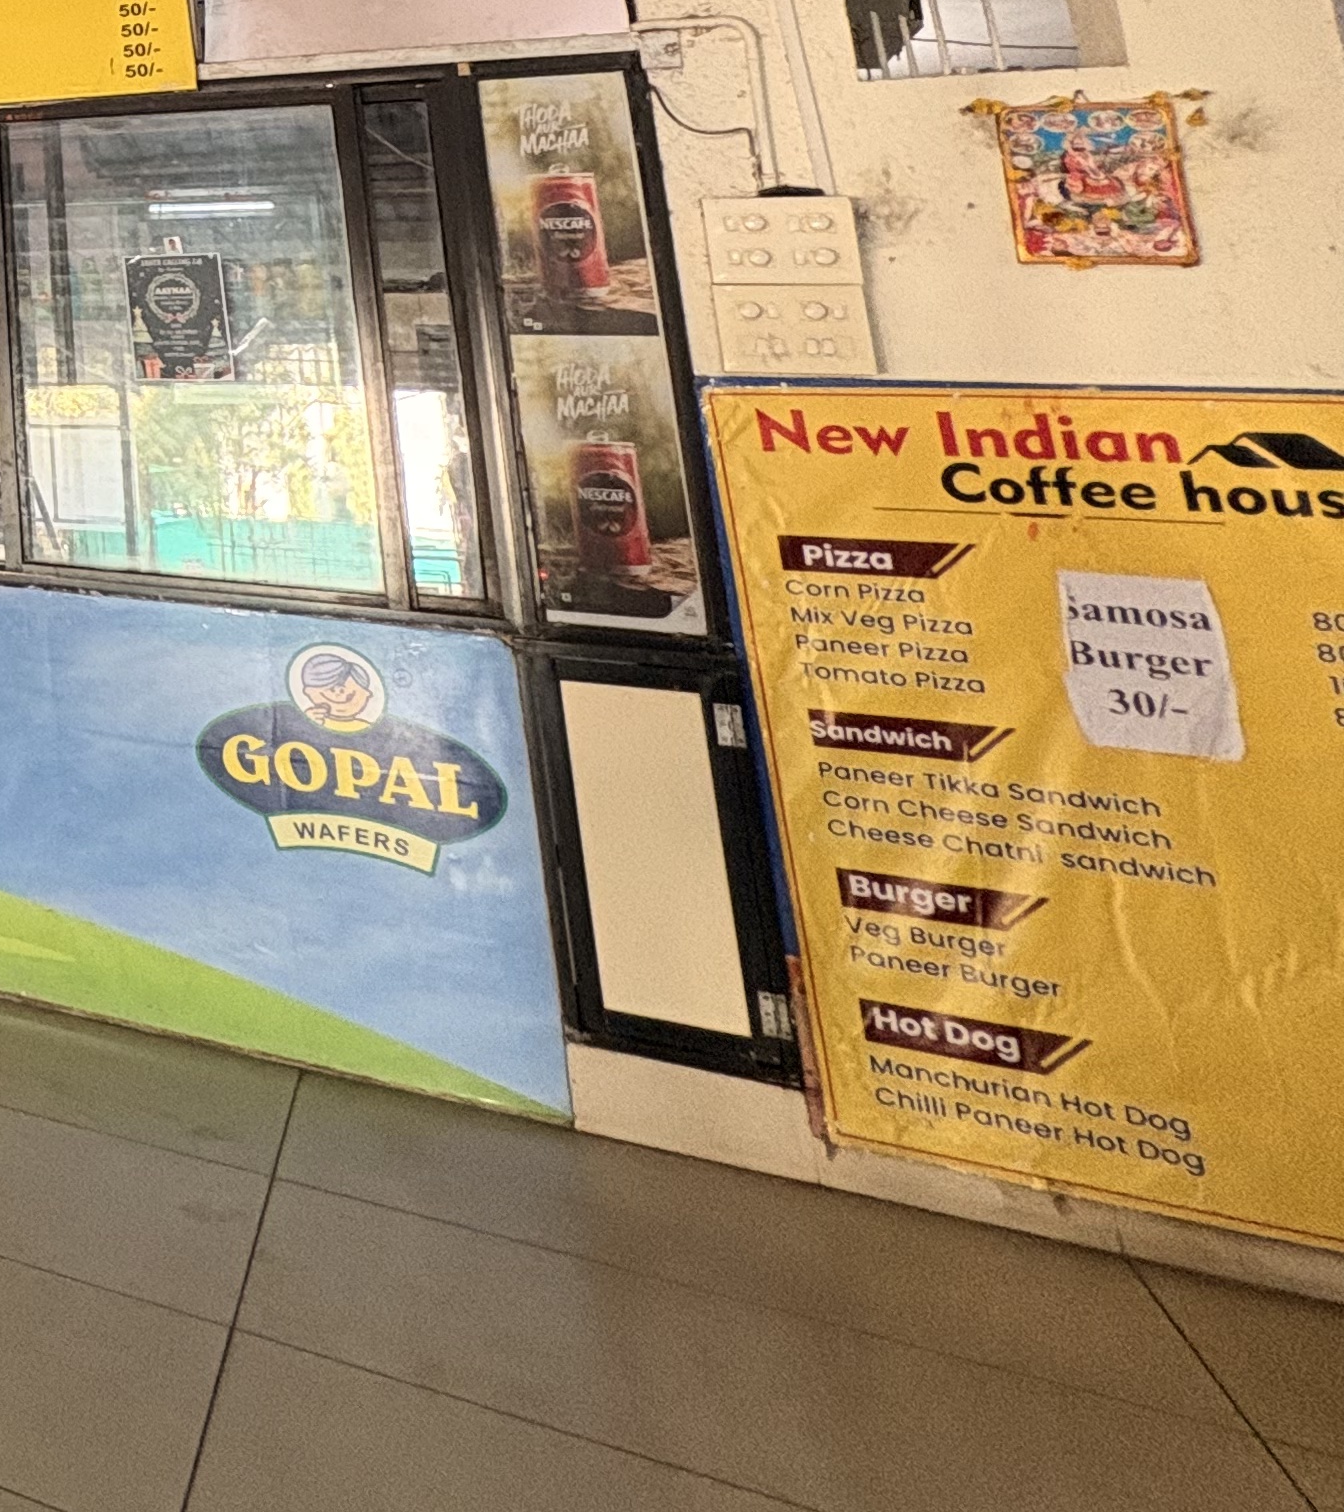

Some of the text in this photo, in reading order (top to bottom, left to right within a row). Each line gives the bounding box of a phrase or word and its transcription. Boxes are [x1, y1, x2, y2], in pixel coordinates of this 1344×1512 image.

[519, 101, 571, 129] THODA
[520, 128, 589, 157] MACHAA
[553, 363, 611, 390] THODA
[558, 393, 629, 422] MACHAA
[756, 408, 1182, 464] New Indian
[942, 462, 1157, 511] Coffee
[803, 544, 894, 572] Pizza
[785, 578, 925, 605] Corn Pizza
[791, 606, 973, 637] Mix Veg Pizza
[795, 634, 969, 664] Paneer Pizza
[1070, 640, 1213, 681] Burger
[802, 662, 986, 695] Tomato Pizza
[1108, 689, 1188, 718] 30/-
[810, 720, 952, 754] Sandwich
[222, 734, 479, 819] GOPAL
[818, 762, 1162, 818] Paneer Tikka Sandwich
[293, 821, 409, 857] WAFERS
[822, 791, 1172, 851] Corn Cheese Sandwich
[827, 820, 1216, 887] Cheese Chatni sandwich
[849, 876, 972, 916] Burger
[845, 915, 1006, 958] Veg Burger
[851, 946, 1061, 999] Paneer Burger
[871, 1007, 1021, 1064] Hot Dog
[870, 1056, 1191, 1143] Manchurian Hot Dog
[875, 1087, 1206, 1177] Chilli Paneer Hot Dog
